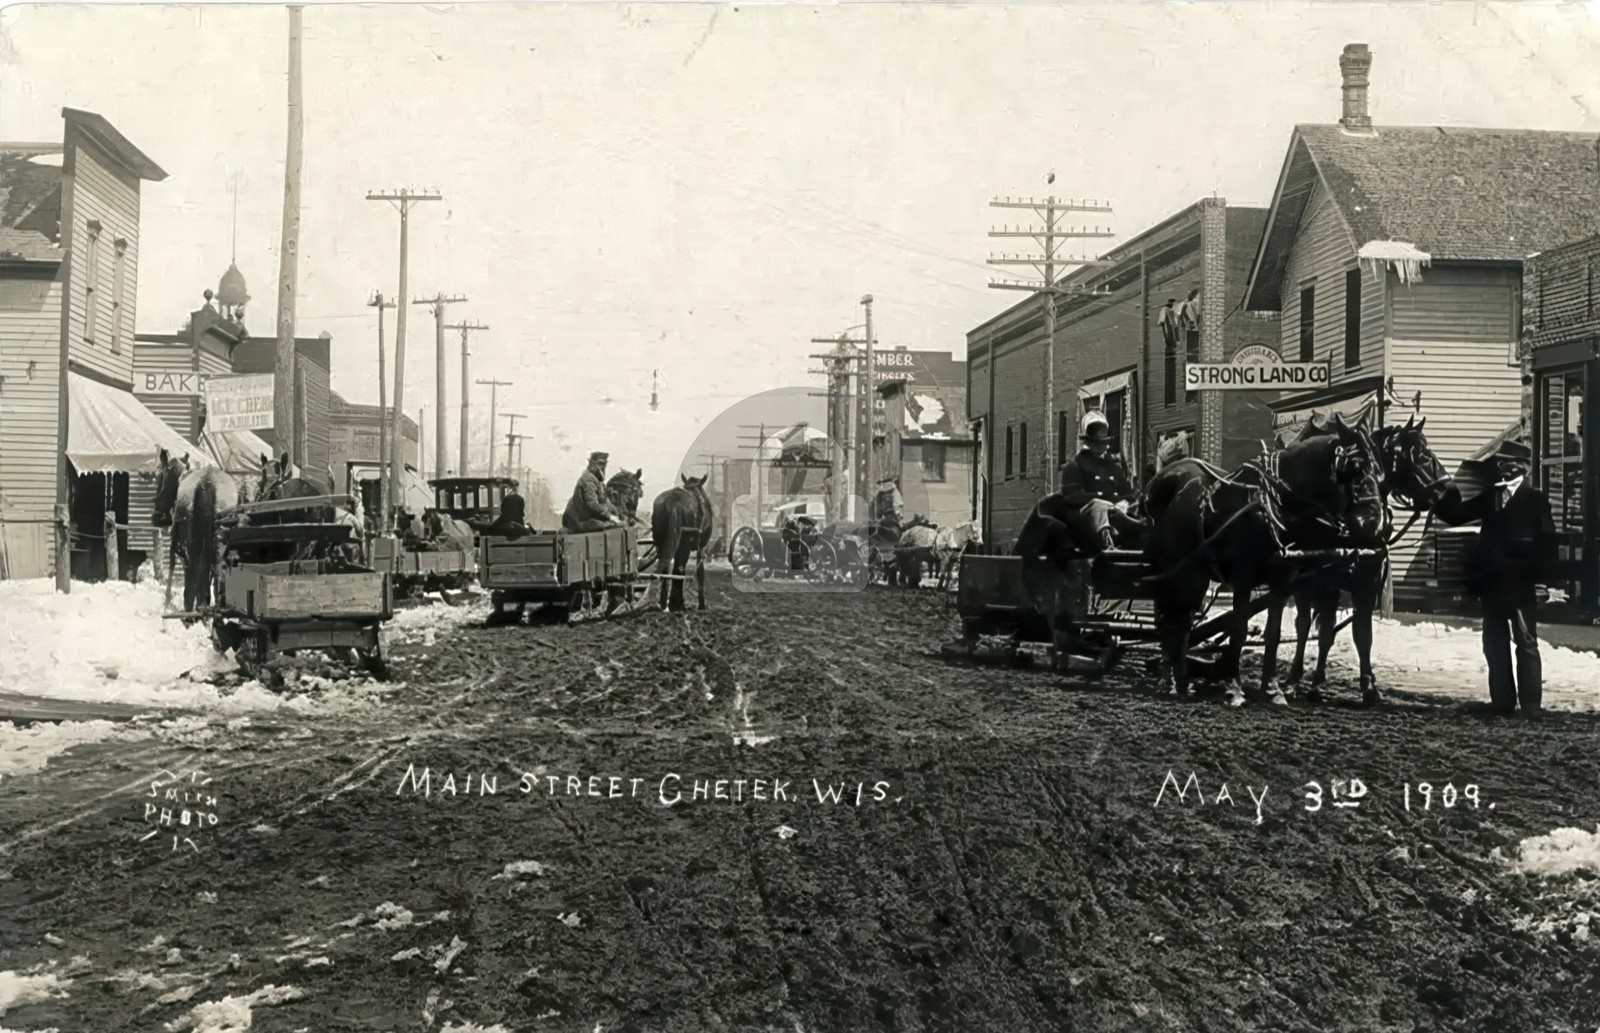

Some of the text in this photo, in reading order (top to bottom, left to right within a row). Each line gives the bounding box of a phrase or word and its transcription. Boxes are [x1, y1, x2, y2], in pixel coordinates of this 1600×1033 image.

[1188, 366, 1328, 385] STRONG LAND CO
